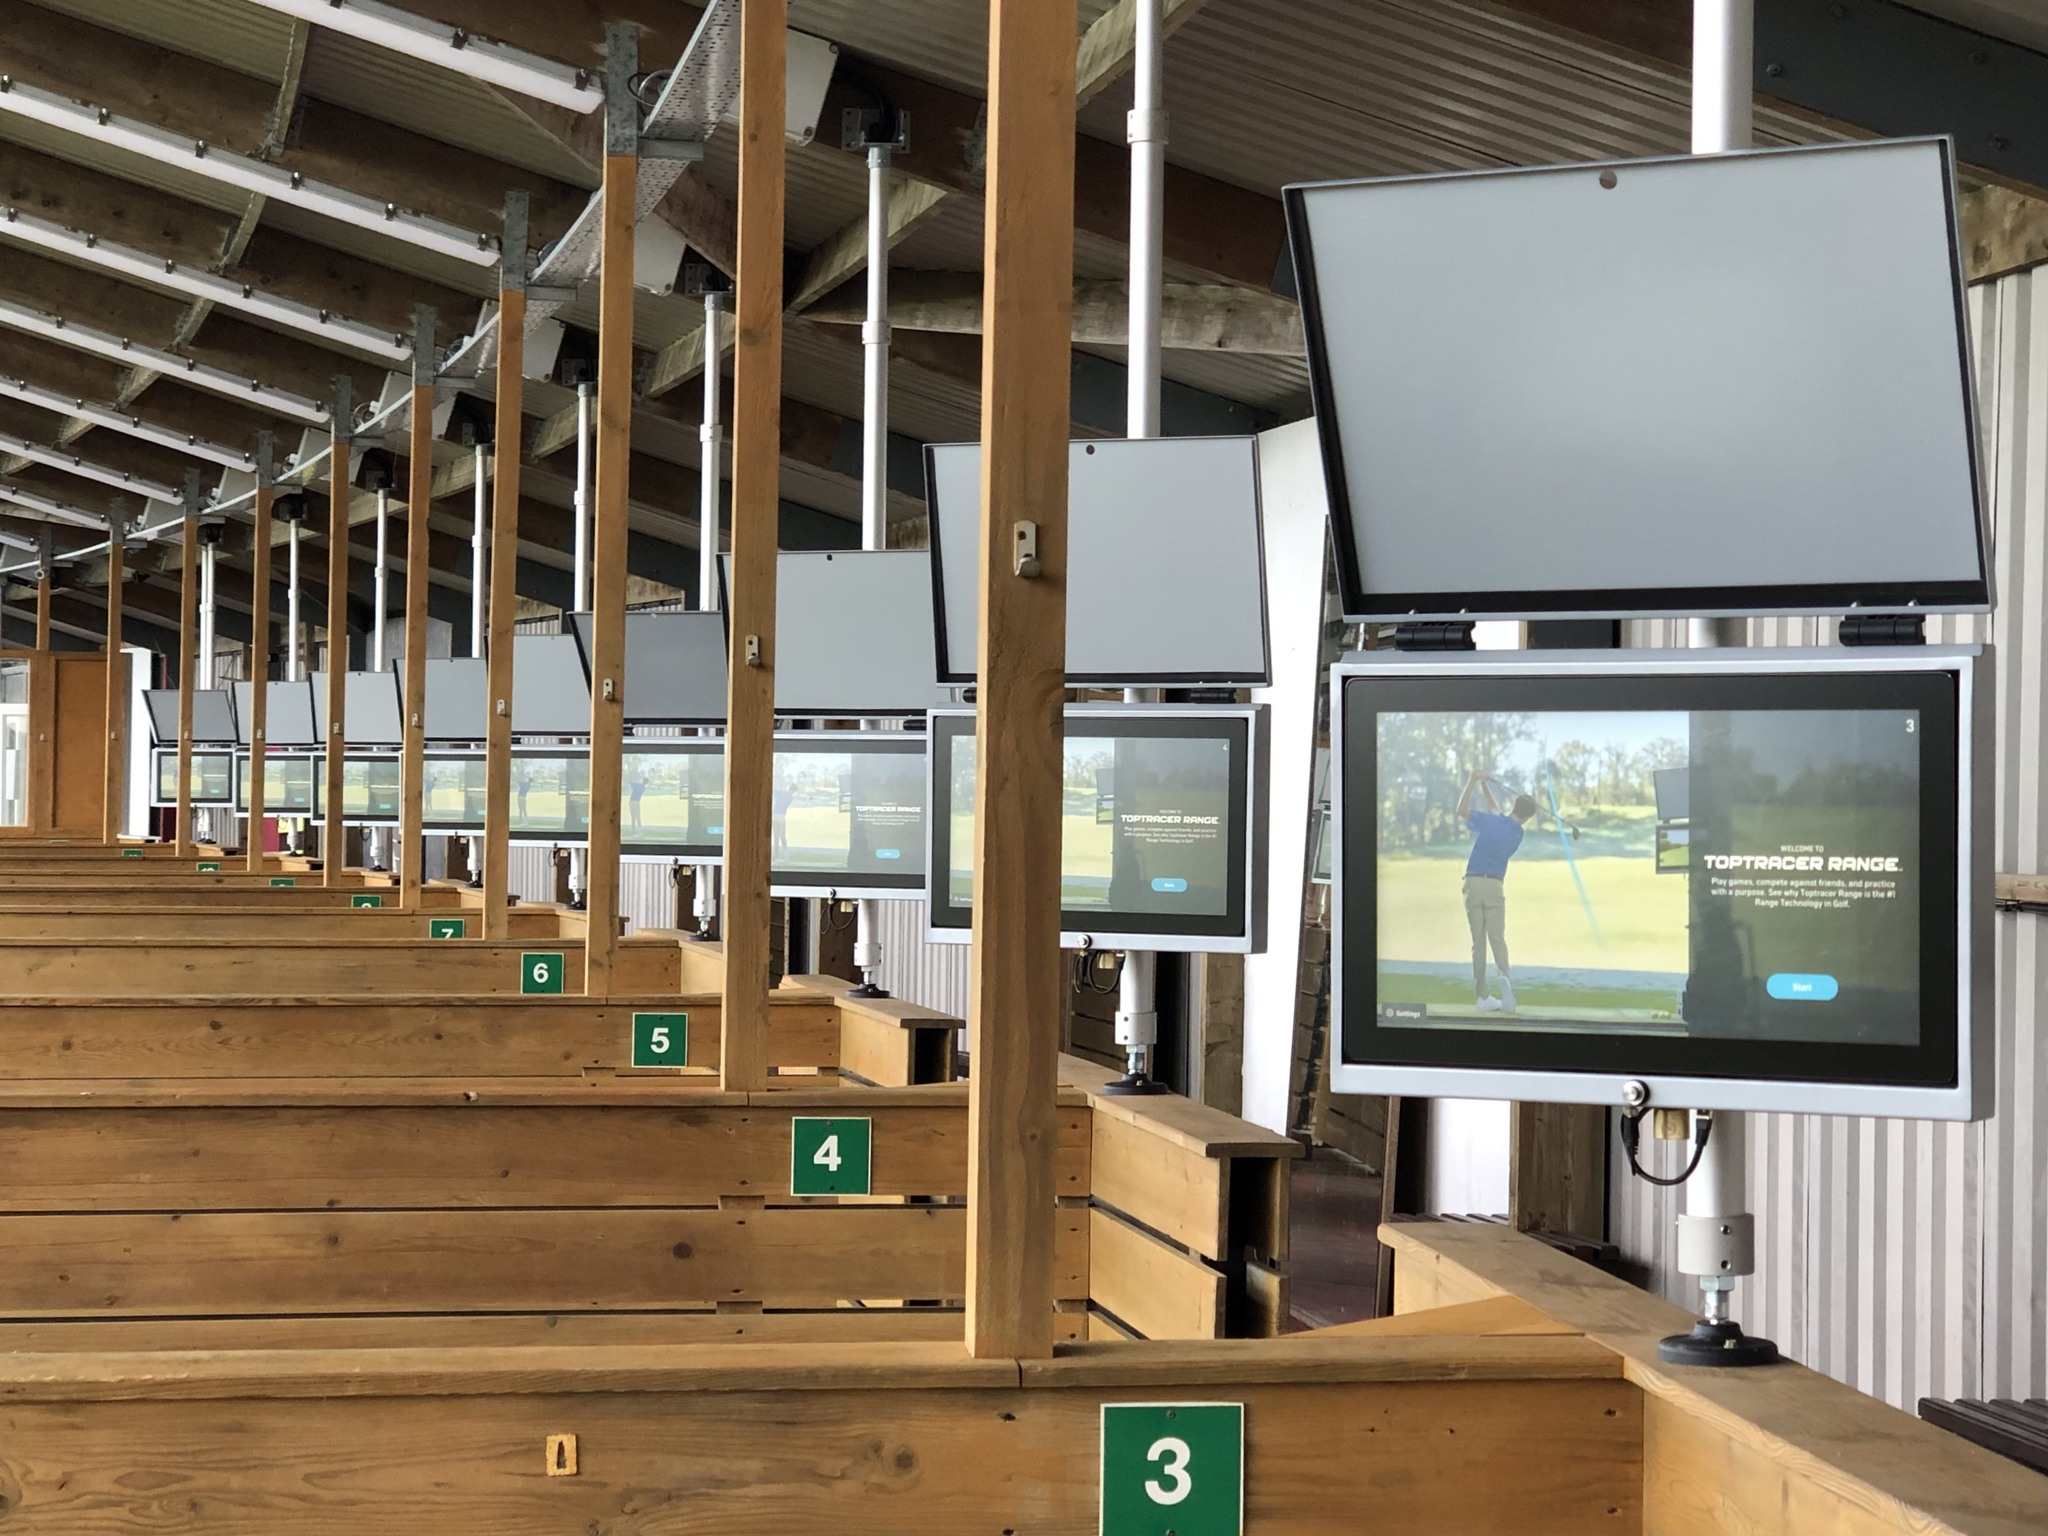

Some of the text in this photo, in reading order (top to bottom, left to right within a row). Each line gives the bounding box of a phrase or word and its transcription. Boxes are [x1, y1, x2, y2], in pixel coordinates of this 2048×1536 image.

[1905, 718, 1915, 733] 3
[1120, 814, 1219, 825] TOPTRACER RANGE
[1780, 844, 1825, 853] WELCOME TO
[1703, 855, 1900, 872] TOPTRACER RANGE
[1711, 877, 1727, 887] Play
[1756, 879, 1789, 887] compete
[1789, 879, 1817, 888] against
[1848, 880, 1863, 888] and
[1864, 880, 1896, 889] practice
[1711, 888, 1727, 896] with
[1768, 888, 1783, 896] See
[1783, 889, 1799, 898] why
[1800, 889, 1837, 898] Toptracer
[1838, 890, 1863, 900] Range
[1864, 890, 1871, 898] is
[1872, 890, 1885, 898] the
[1754, 898, 1779, 908] Range
[1780, 899, 1823, 909] Technology
[1824, 900, 1832, 908] in
[441, 928, 454, 939] 7
[533, 962, 549, 983] 6
[650, 1027, 670, 1054] 5
[813, 1134, 842, 1172] 4
[1145, 1437, 1192, 1506] 3
